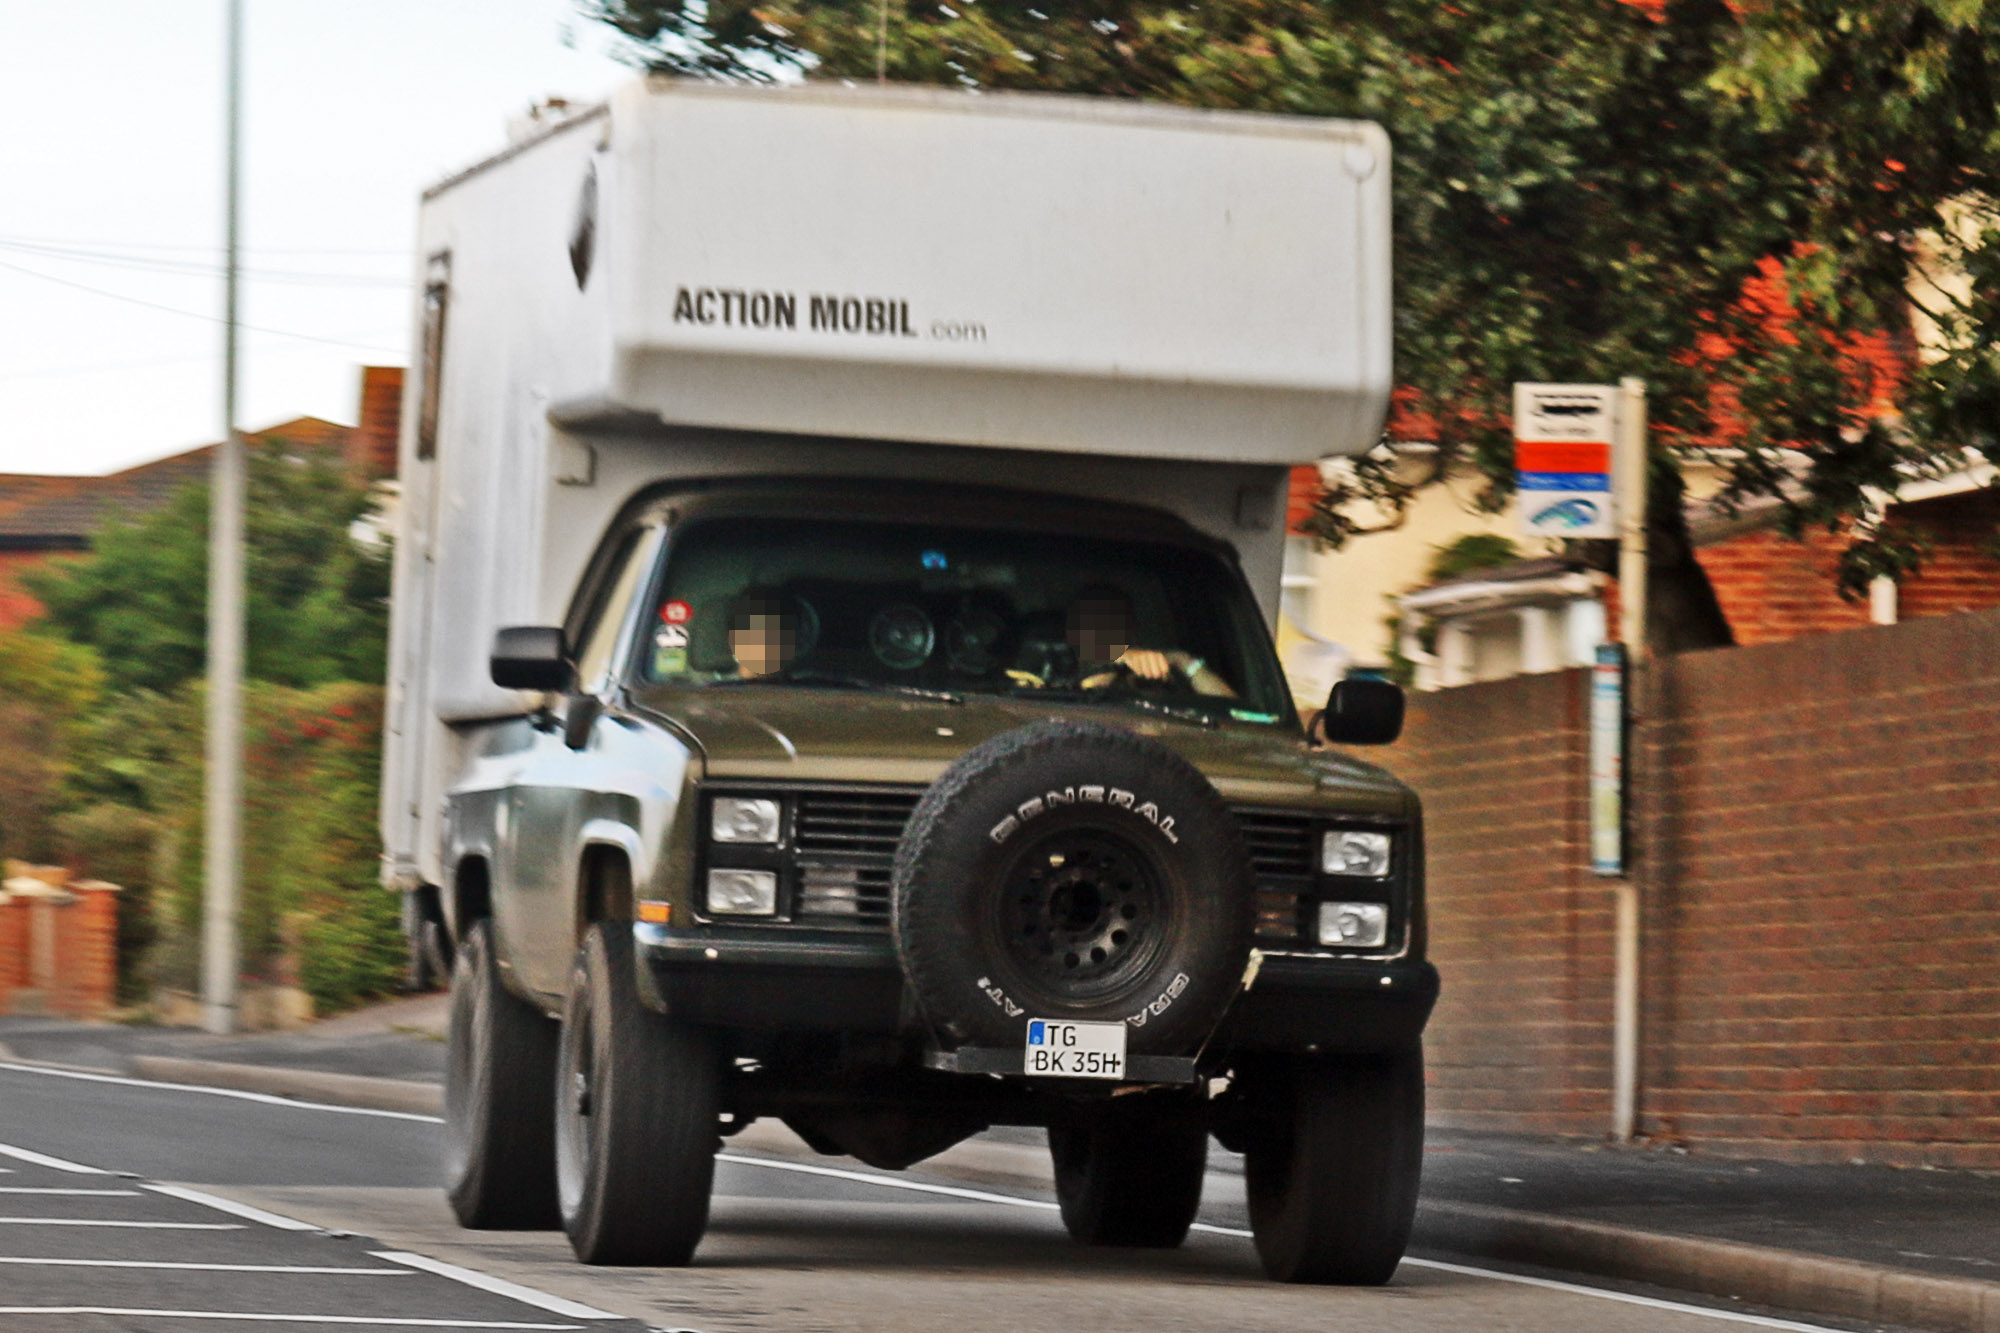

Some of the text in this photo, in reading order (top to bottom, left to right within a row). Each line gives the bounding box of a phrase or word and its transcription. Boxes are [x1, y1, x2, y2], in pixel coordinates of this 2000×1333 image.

[673, 284, 796, 331] ACTION
[810, 294, 917, 338] MOBIL
[1047, 1025, 1076, 1047] TG
[1035, 1050, 1117, 1073] BK 35H
